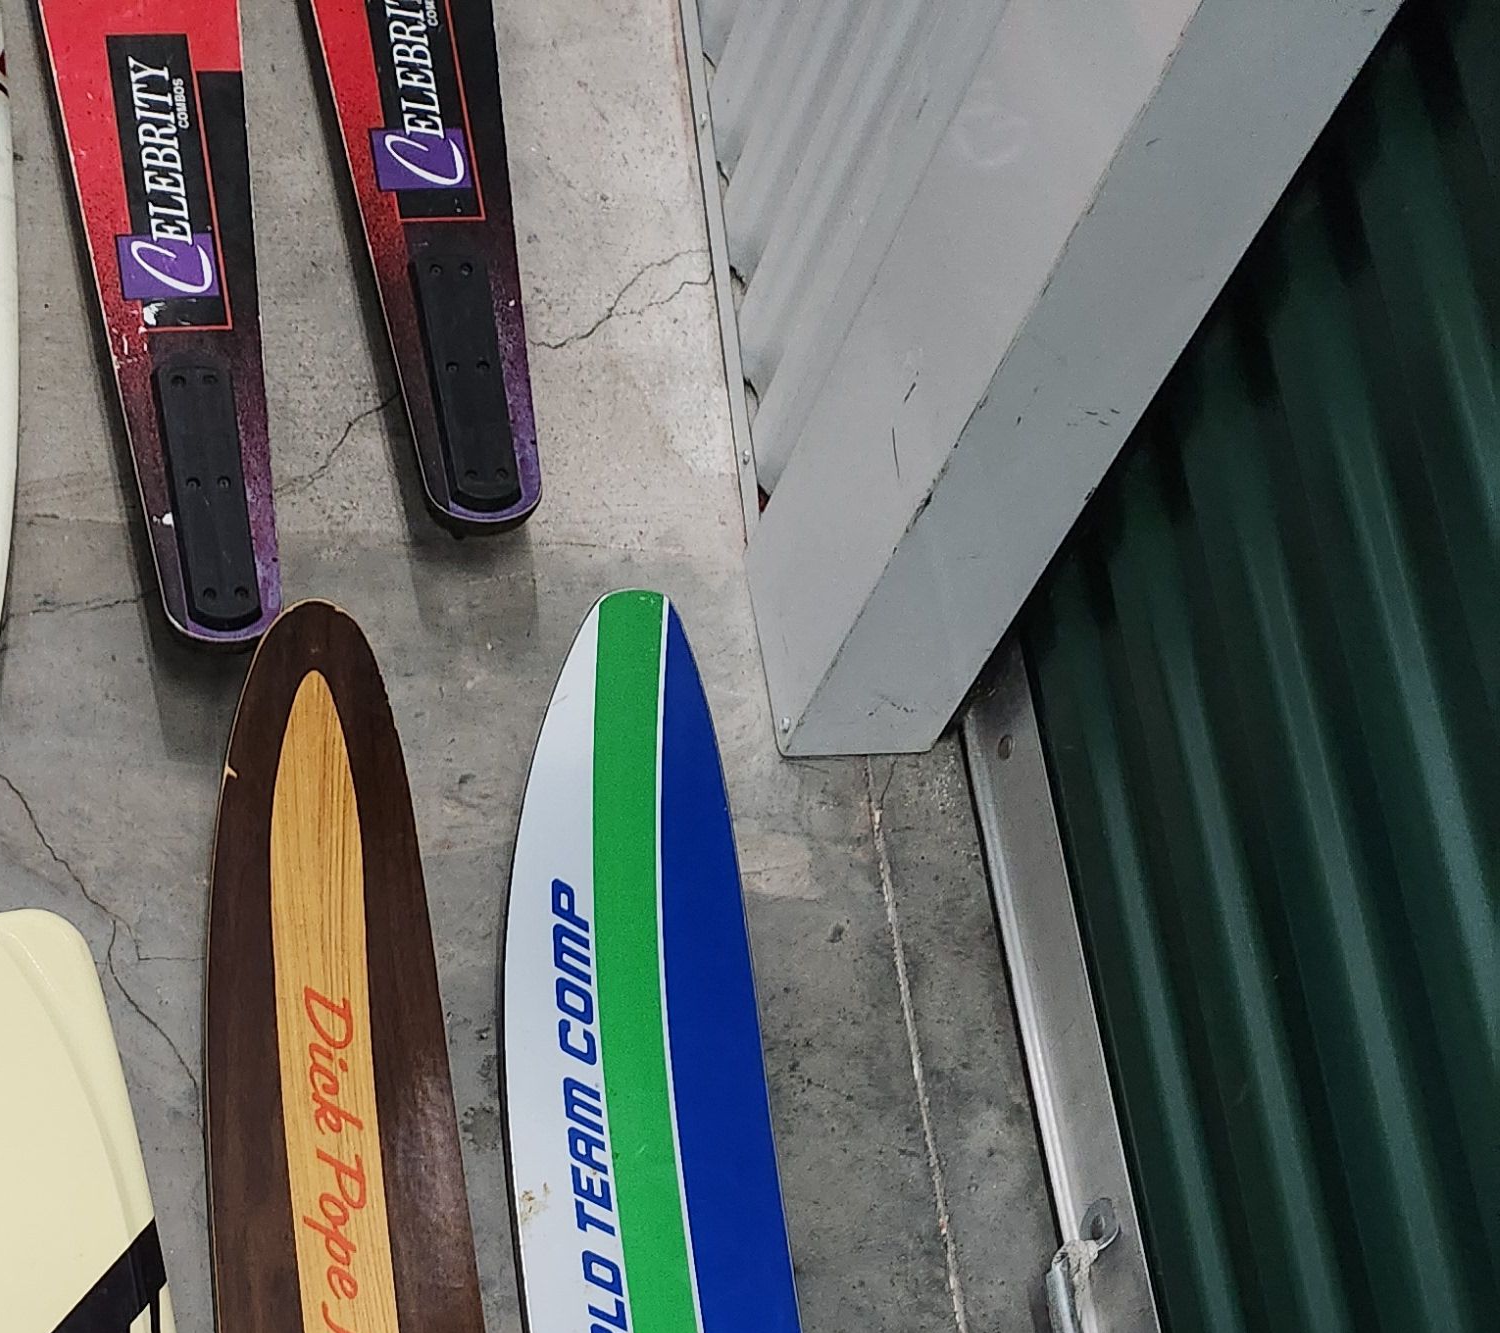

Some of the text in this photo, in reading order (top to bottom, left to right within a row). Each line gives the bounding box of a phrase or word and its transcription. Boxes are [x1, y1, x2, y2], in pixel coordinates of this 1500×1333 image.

[128, 55, 213, 294] CELEBRITY
[171, 78, 189, 130] COMBOS
[550, 878, 600, 1066] COMP
[302, 985, 366, 1141] Dick
[303, 1151, 368, 1299] Pope
[564, 1076, 620, 1236] TEAM
